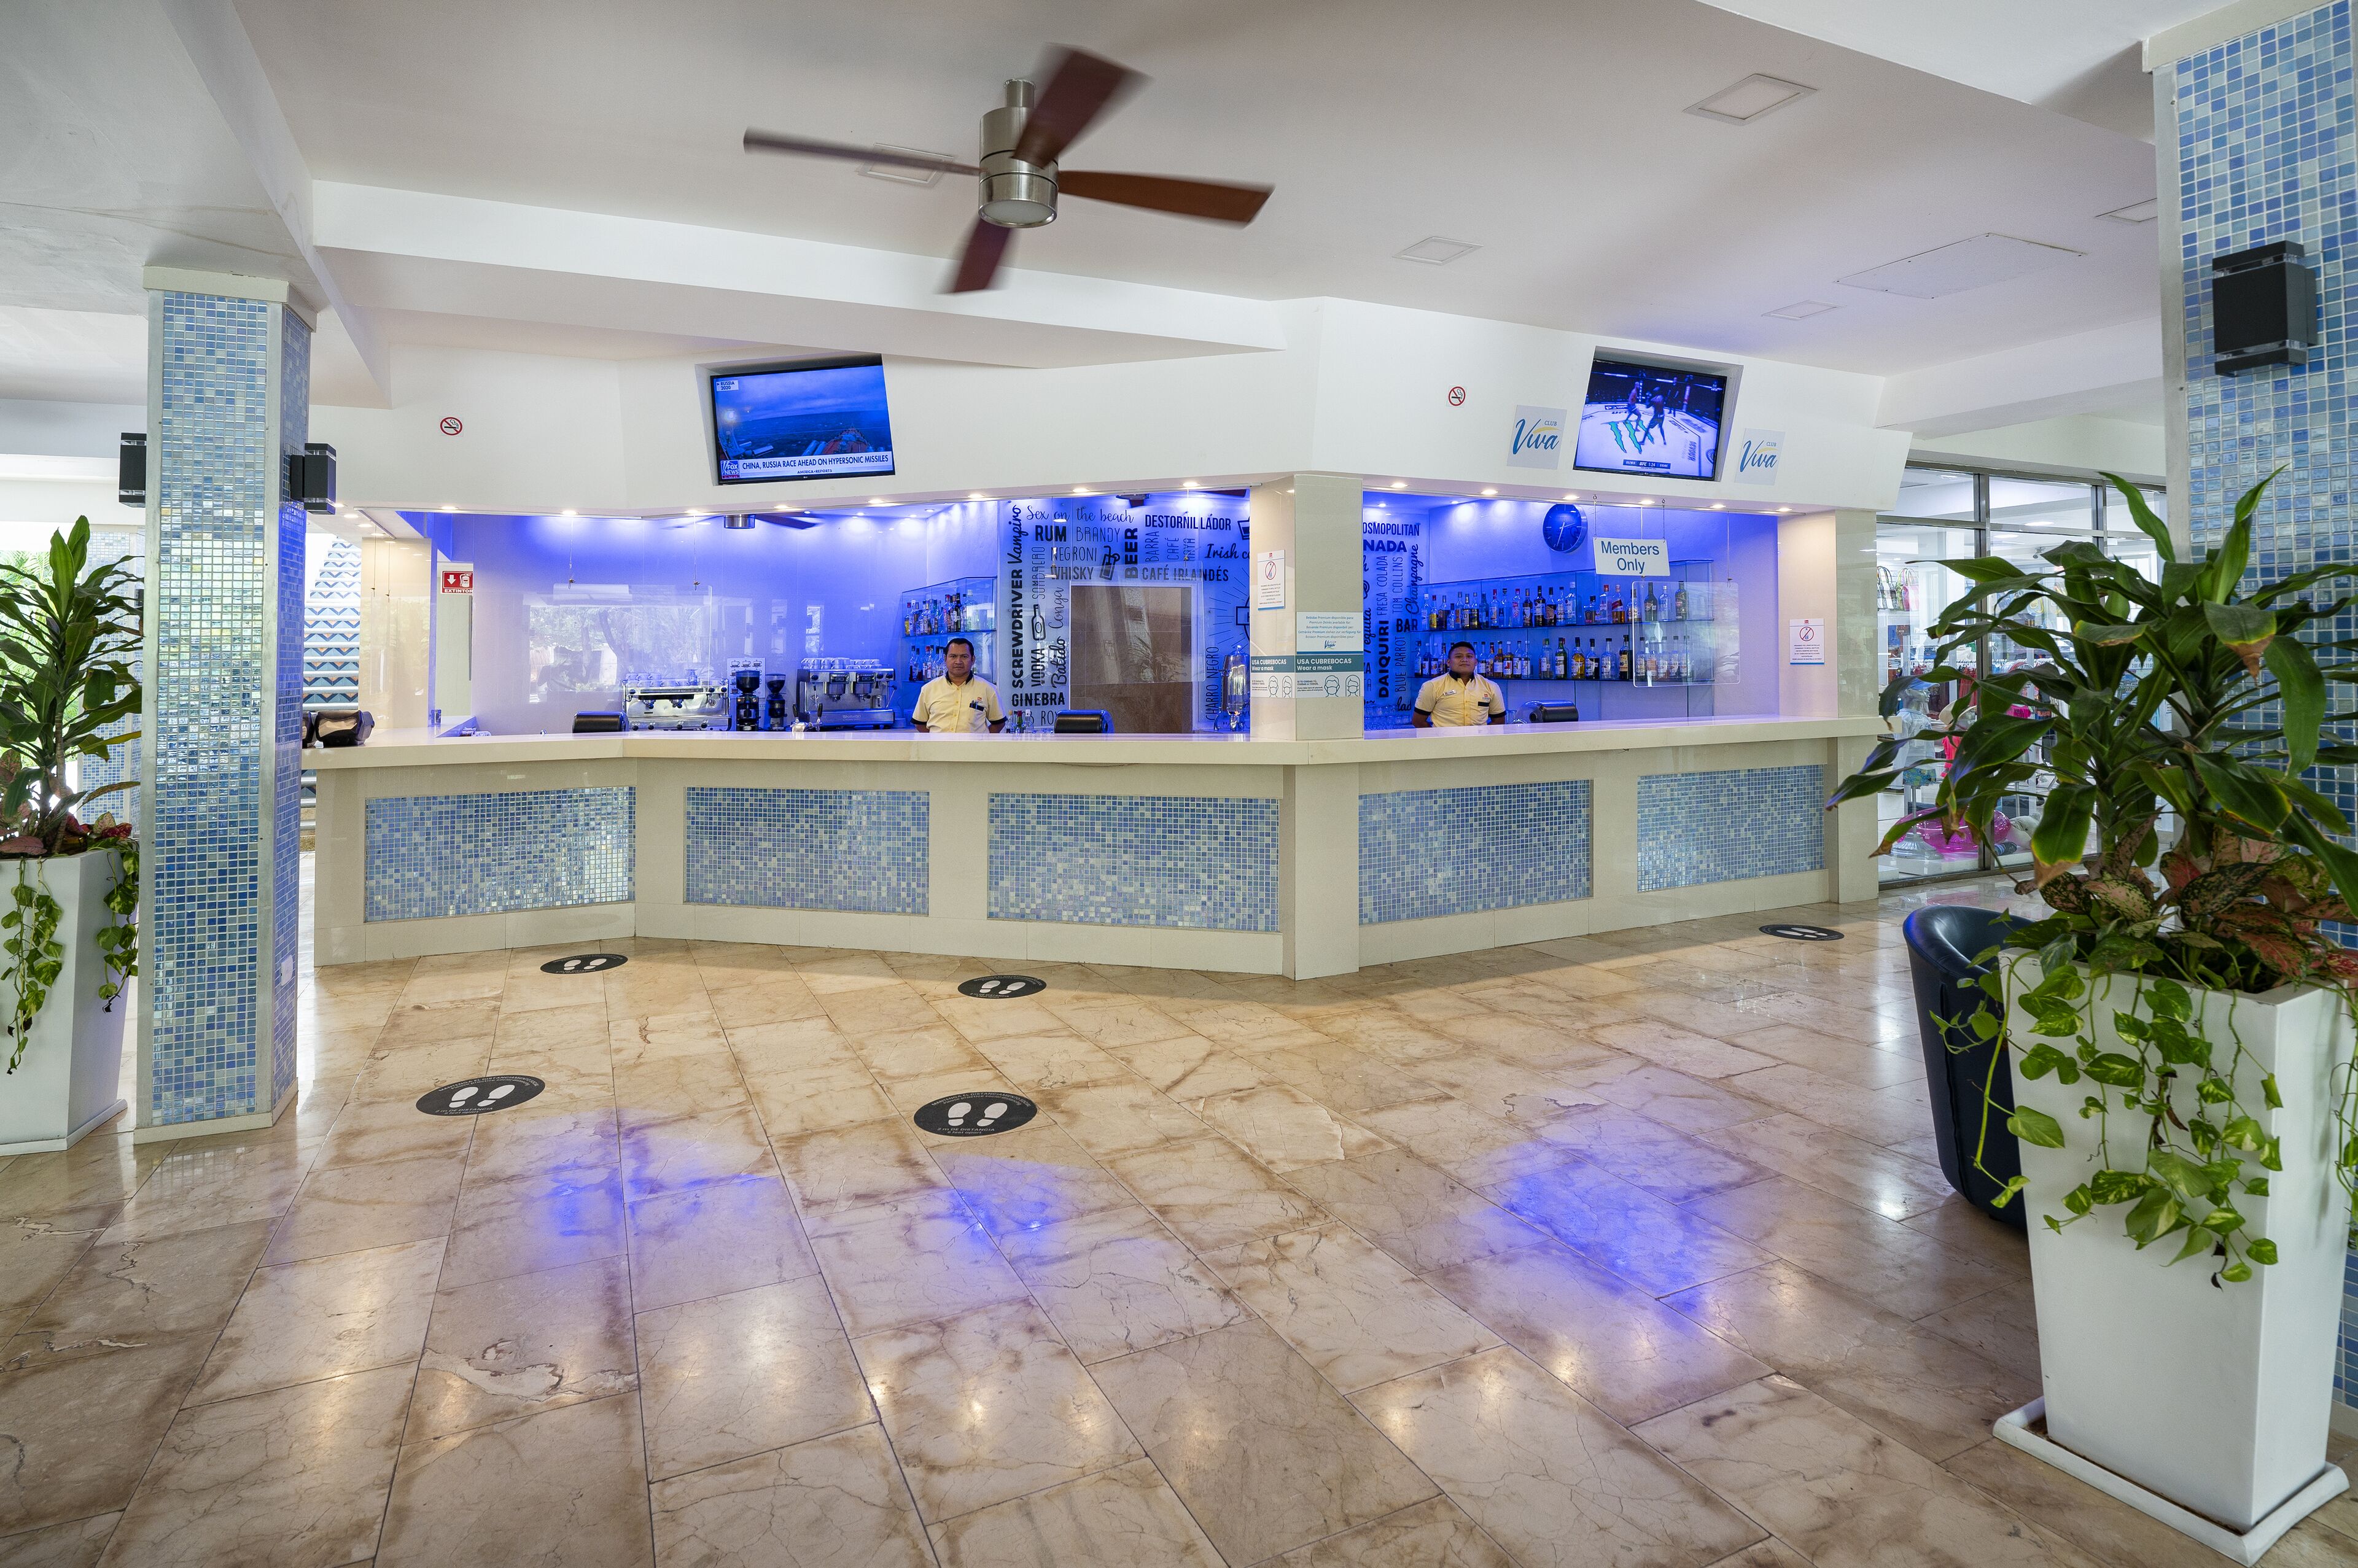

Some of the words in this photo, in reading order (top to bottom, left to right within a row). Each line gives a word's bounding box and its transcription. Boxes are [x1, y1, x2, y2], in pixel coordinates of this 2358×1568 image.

[1513, 419, 1559, 454] Viva
[828, 456, 864, 465] HYPERSONIC
[865, 454, 889, 463] MISSILES
[1740, 440, 1777, 472] Viva
[1026, 505, 1049, 520] Sex
[1054, 511, 1070, 522] on
[1076, 507, 1096, 521] the
[1100, 508, 1135, 523] beach
[1145, 514, 1231, 530] DESTORNILLADOR
[1008, 505, 1029, 564] Vampiro
[1035, 525, 1067, 542] RUM
[1076, 526, 1121, 543] BRANDY
[1145, 531, 1160, 562] BARRA
[1051, 546, 1097, 562] NEGRONI
[1124, 527, 1138, 579] BEER
[1165, 537, 1179, 560] CAFÉ
[1204, 543, 1239, 559] Irish
[1601, 540, 1660, 556] Members
[1032, 546, 1045, 600] SOMBRERO
[1051, 566, 1094, 580] WHISKY
[1142, 564, 1169, 580] CAFÉ
[1173, 565, 1229, 581] IRLANDÉS
[1376, 555, 1388, 587] COLADA
[1392, 557, 1403, 593] COLLINS
[1404, 543, 1424, 615] Champagne
[1617, 557, 1645, 574] Only
[1048, 587, 1069, 629] Conga
[1376, 592, 1388, 616] FRESA
[1392, 597, 1403, 614] TOM
[1011, 569, 1024, 689] SCREWDRIVER
[1396, 618, 1418, 633] BAR
[1048, 635, 1068, 688] Batido
[1206, 646, 1219, 679] NEGRO
[1379, 620, 1391, 698] DAIQUIRI
[1395, 636, 1407, 667] PARROT
[1031, 649, 1046, 688] VODKA
[1395, 672, 1406, 693] BLUE
[1011, 692, 1065, 707] GINEBRA
[1205, 684, 1219, 721] CHARRO
[932, 1095, 961, 1106] MANTENGA
